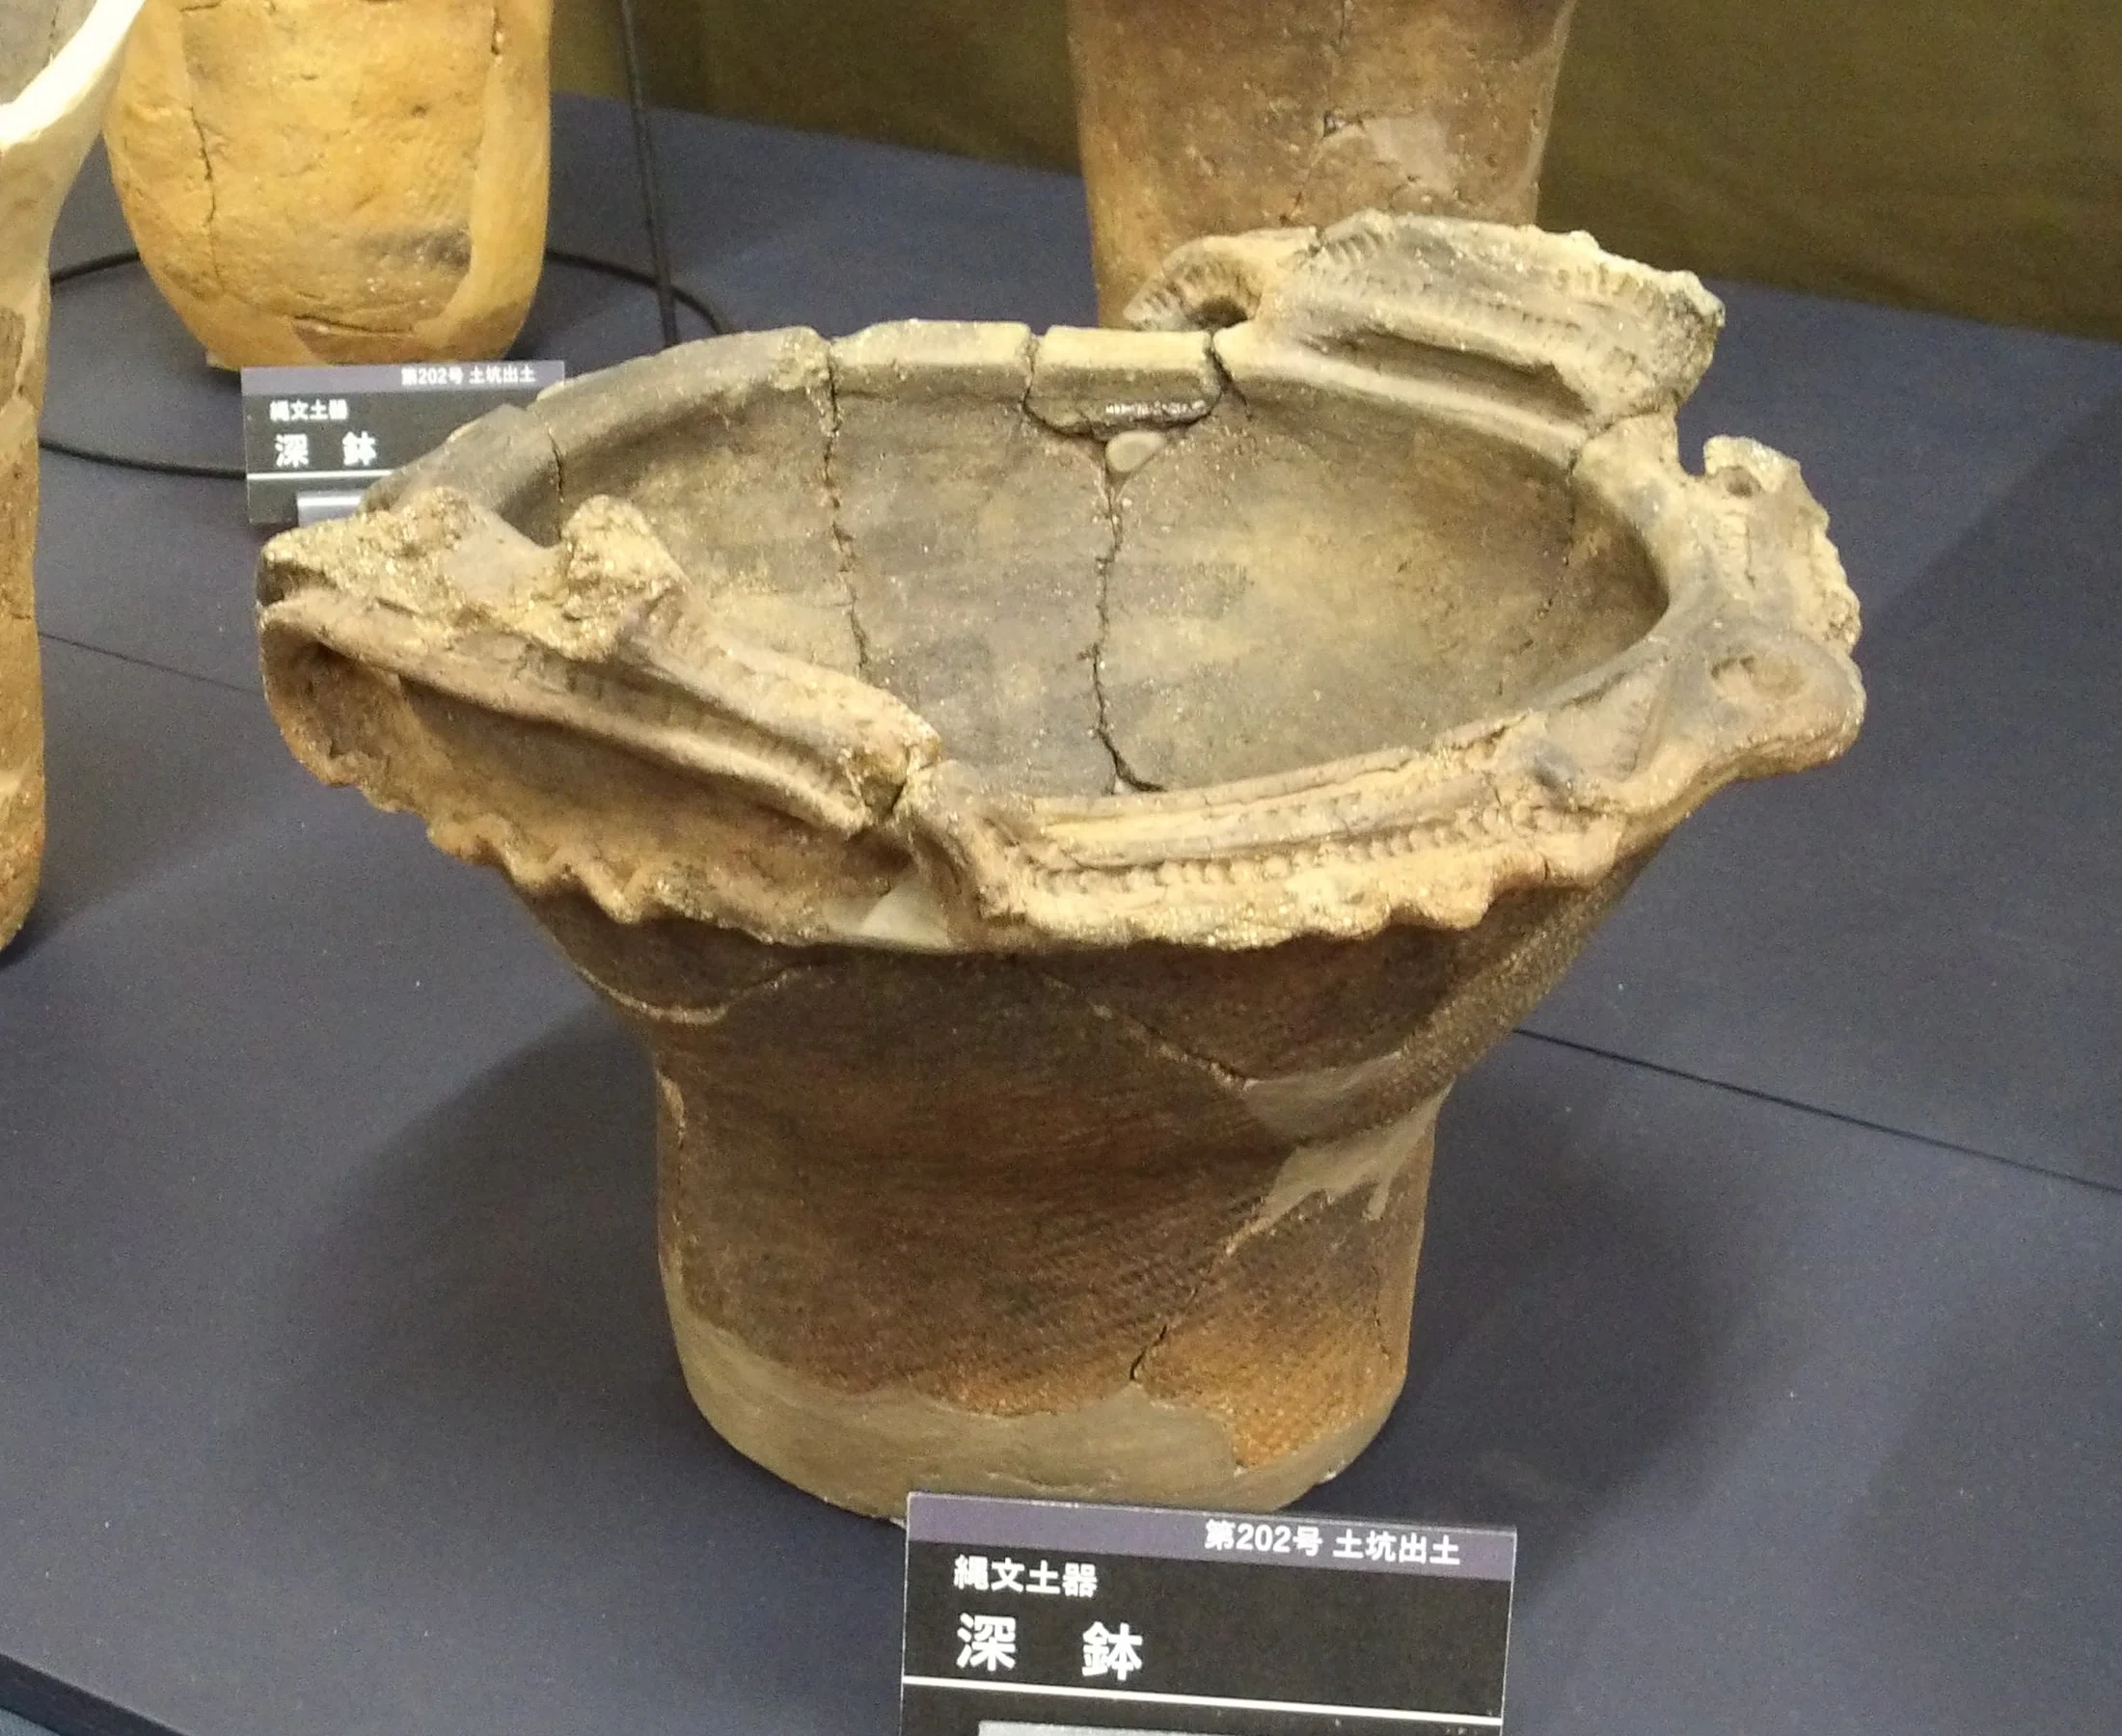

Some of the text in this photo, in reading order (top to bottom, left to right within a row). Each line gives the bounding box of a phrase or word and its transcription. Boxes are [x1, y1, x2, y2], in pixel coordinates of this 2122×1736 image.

[469, 366, 536, 384] 土坑出土
[1205, 1519, 1461, 1567] 第202号 土坑出土
[954, 1554, 1098, 1599] 縄文土器
